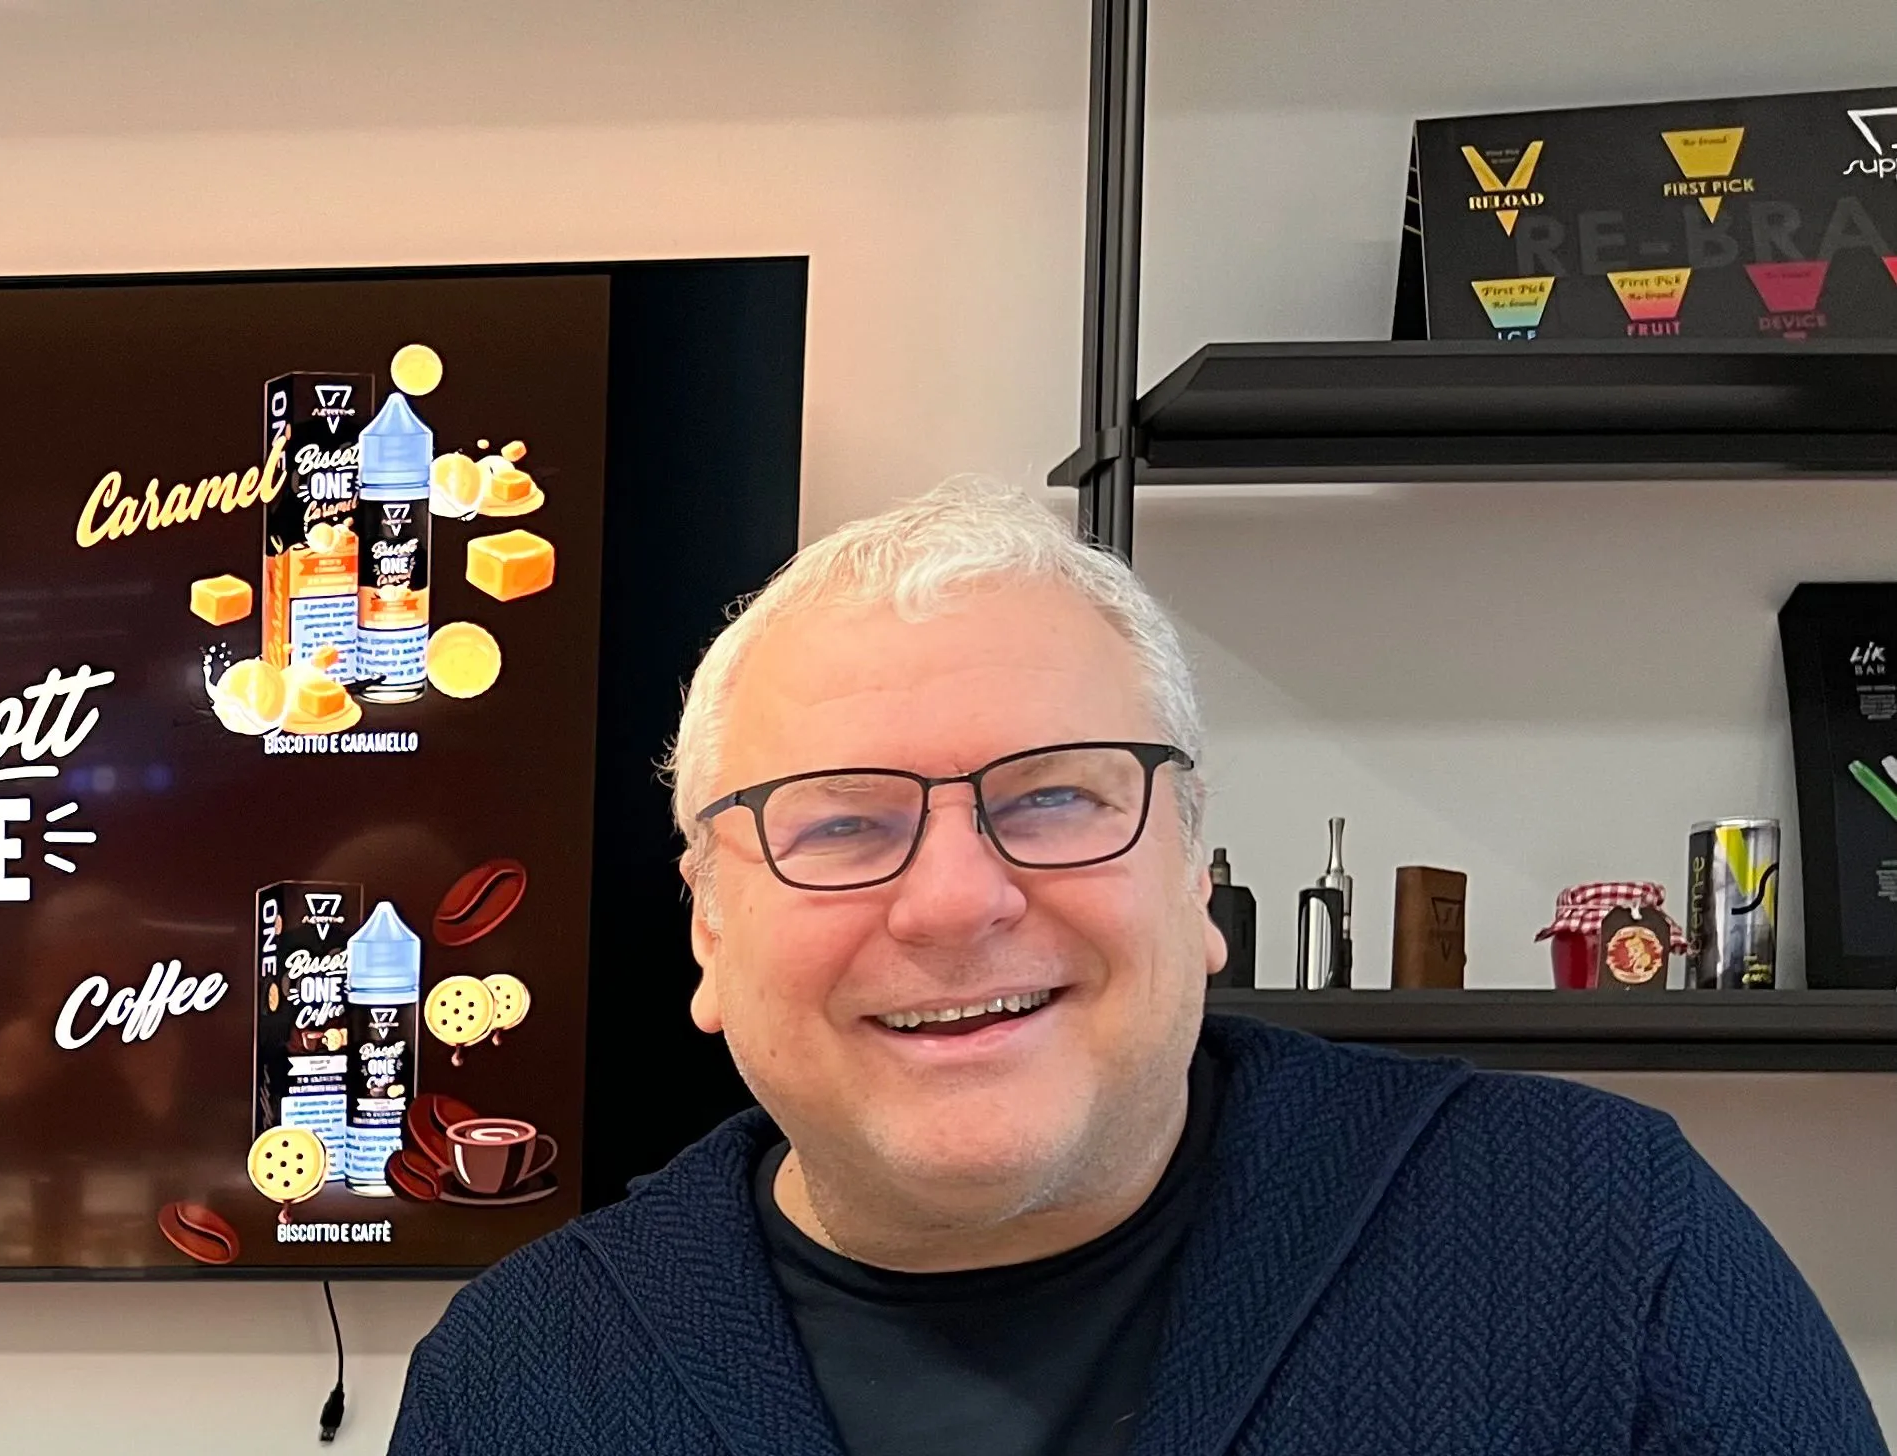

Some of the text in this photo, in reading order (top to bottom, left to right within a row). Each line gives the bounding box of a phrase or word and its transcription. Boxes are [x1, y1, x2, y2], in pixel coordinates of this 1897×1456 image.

[1664, 179, 1755, 197] FIRST PICK
[1469, 192, 1544, 209] RELOAD
[1628, 322, 1683, 337] FRUIT
[1758, 314, 1827, 331] DEVICE
[75, 436, 289, 549] Caramel
[310, 472, 353, 500] ONE
[263, 732, 419, 754] BISCOTTO E CARAMELLO
[261, 899, 278, 977] ONE
[301, 976, 342, 1003] ONE
[54, 959, 229, 1050] Coffee
[277, 1220, 392, 1242] BISCOTTO E CAFFÈ
